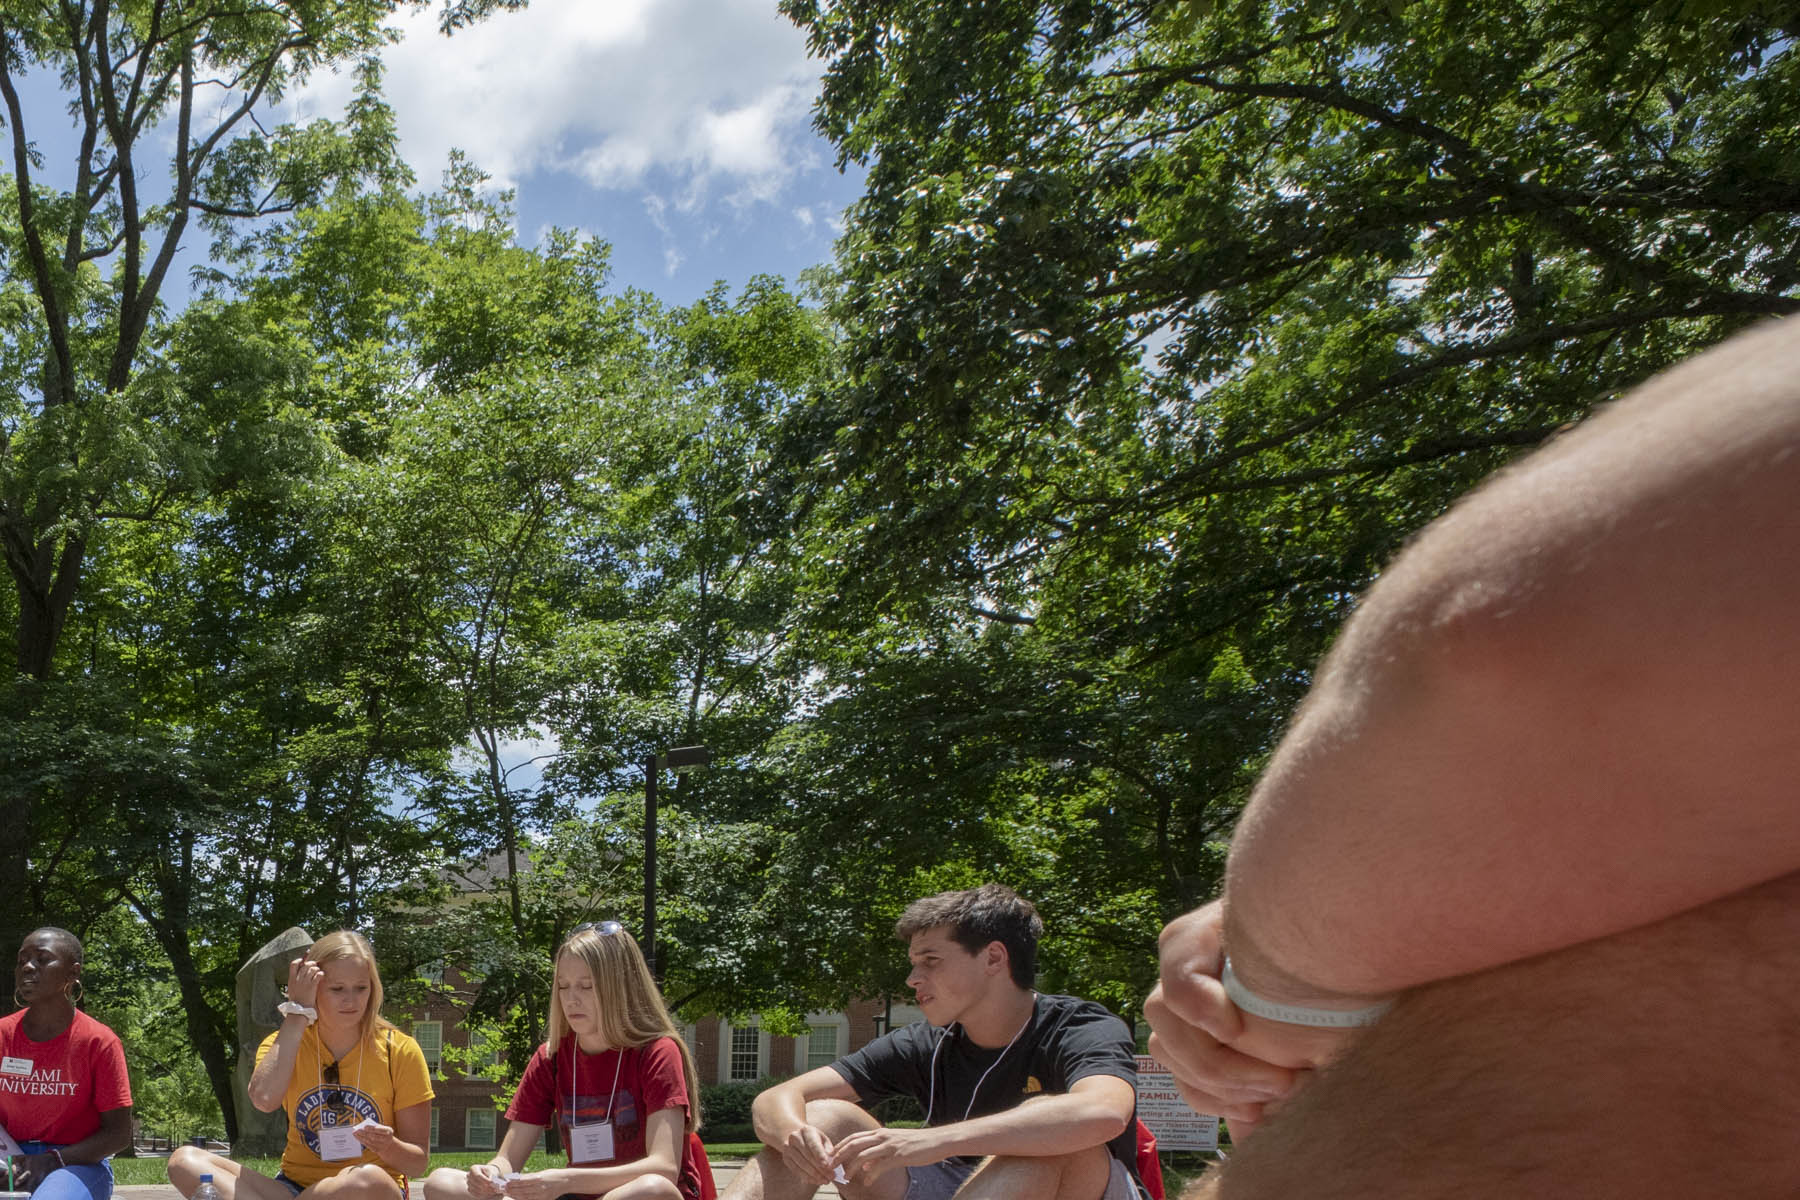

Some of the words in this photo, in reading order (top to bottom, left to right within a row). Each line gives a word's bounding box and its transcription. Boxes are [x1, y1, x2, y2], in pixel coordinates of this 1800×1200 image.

[1139, 1092, 1180, 1100] FAMILY
[298, 1091, 324, 1117] LADY
[322, 1111, 336, 1124] 16
